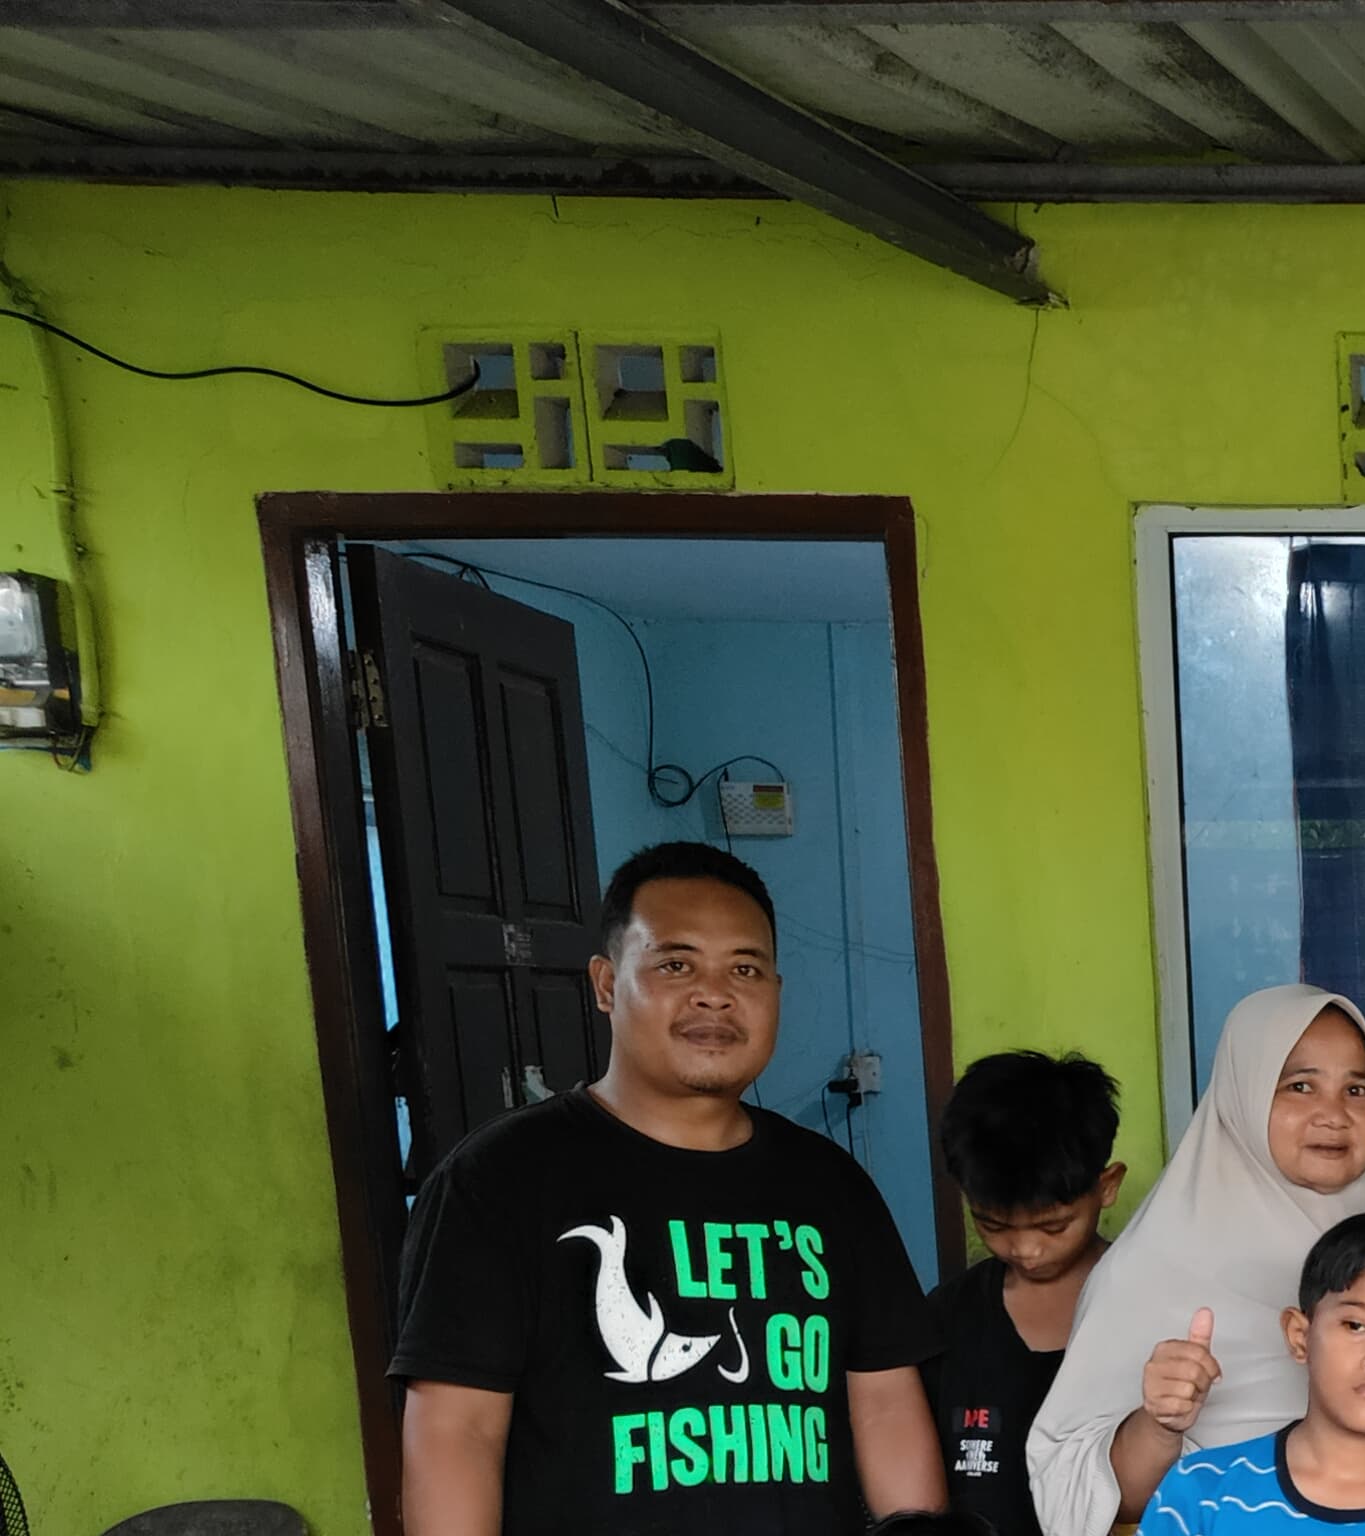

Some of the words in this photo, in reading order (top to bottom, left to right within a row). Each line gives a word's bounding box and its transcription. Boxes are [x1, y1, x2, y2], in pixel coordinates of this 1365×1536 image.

[668, 1220, 830, 1299] LET'S
[765, 1313, 830, 1393] GO
[612, 1404, 829, 1494] FISHING
